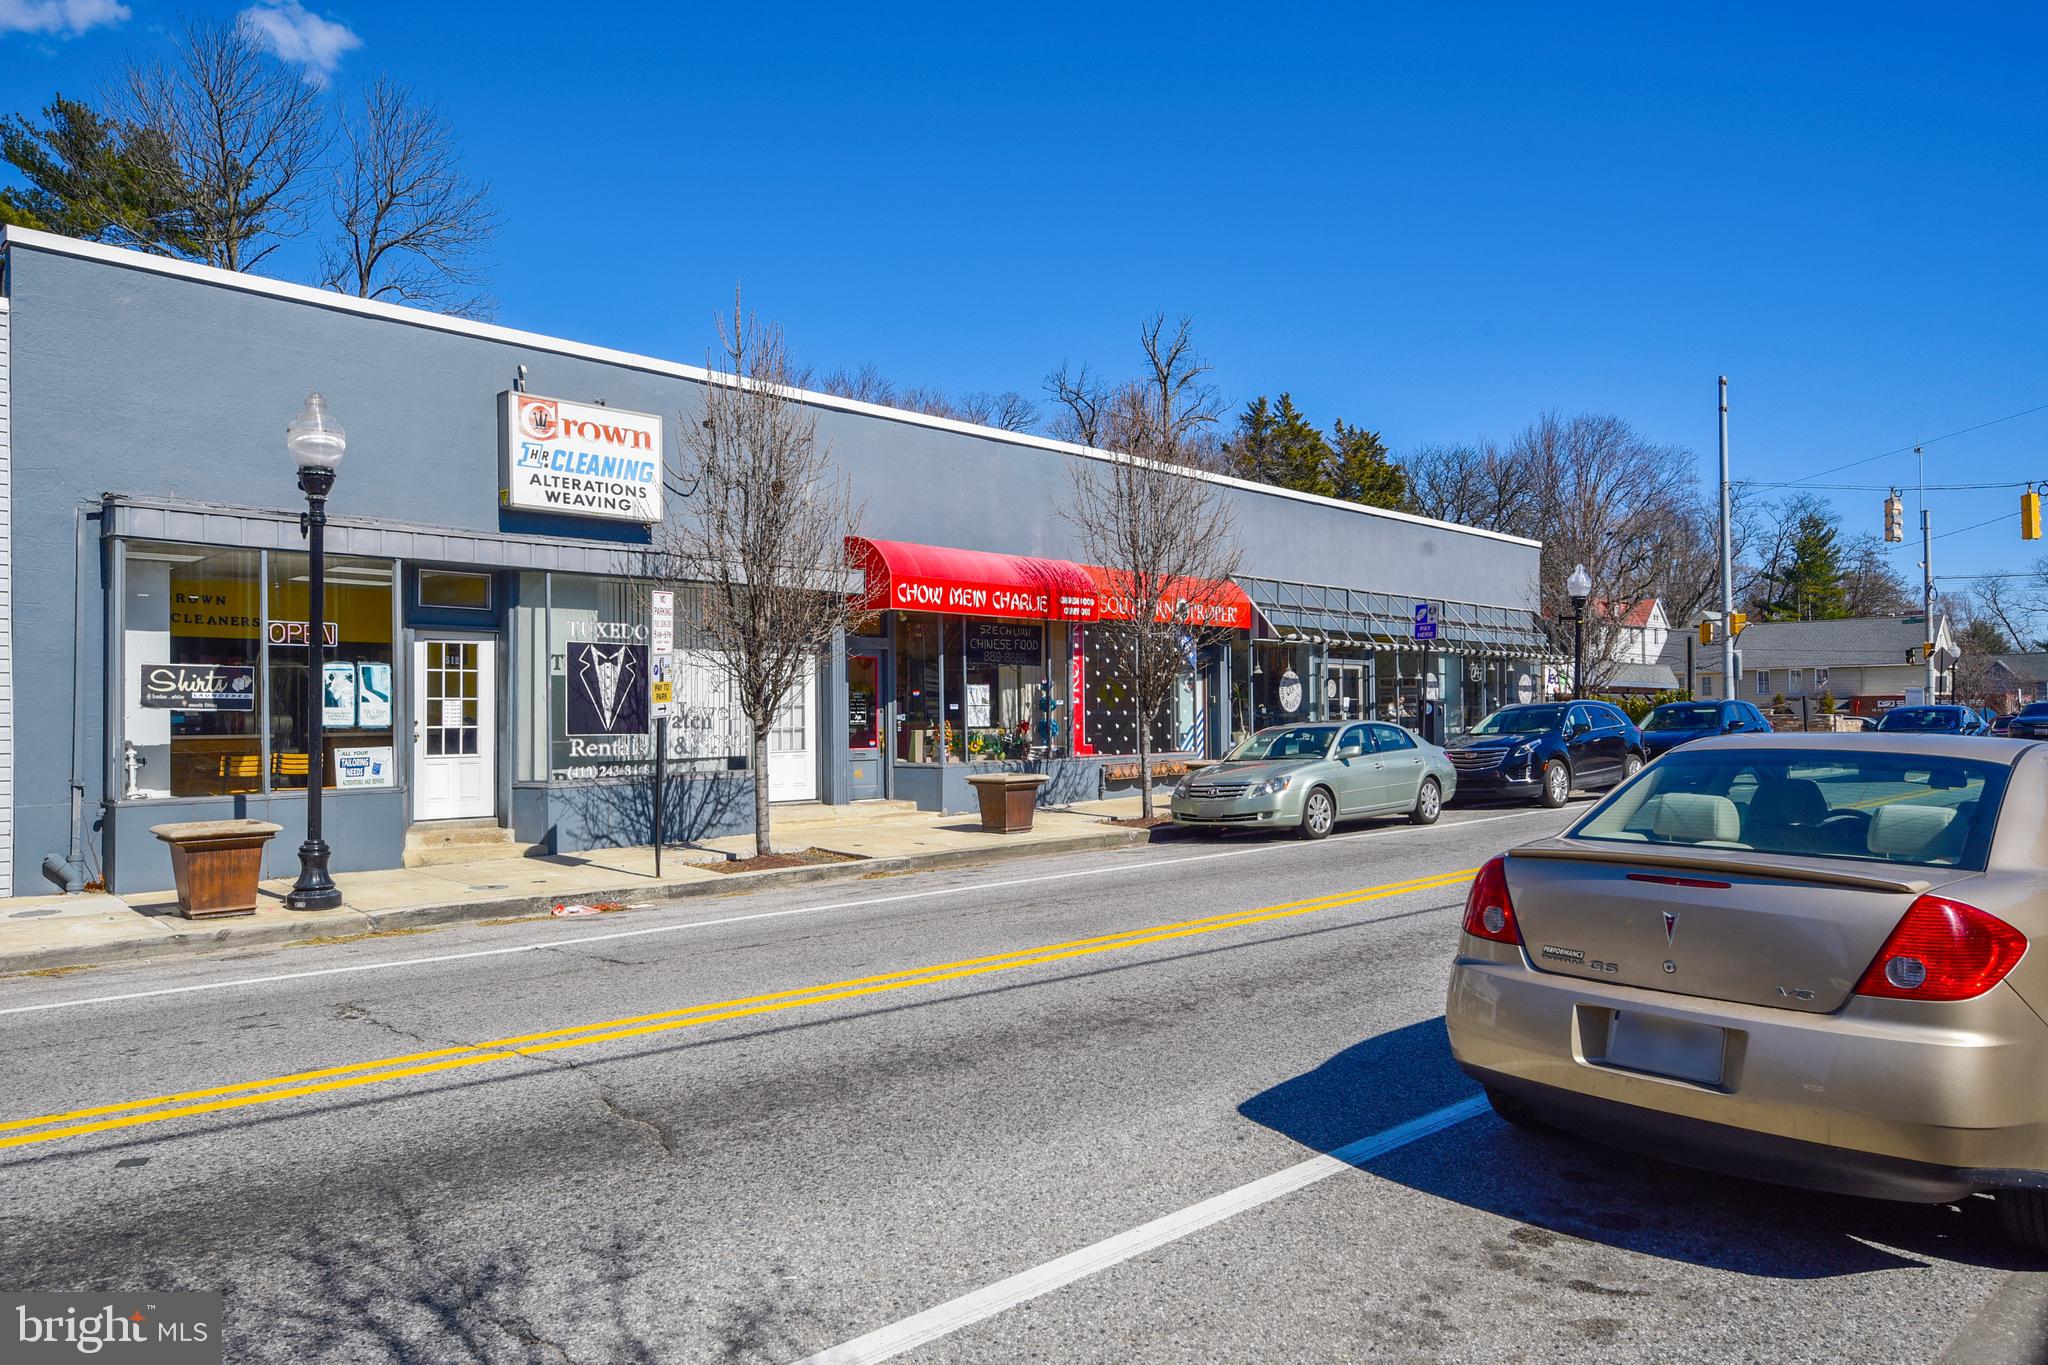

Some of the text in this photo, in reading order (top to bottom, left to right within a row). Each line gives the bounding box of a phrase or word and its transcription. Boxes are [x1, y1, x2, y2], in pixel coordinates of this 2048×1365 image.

[519, 398, 656, 450] Crown
[550, 449, 655, 483] CLEANING
[529, 473, 647, 498] ALTERATIONS
[544, 490, 632, 511] WEAVING
[170, 593, 227, 605] ROWN
[897, 583, 1049, 613] CHOW MEIN CHARLIE
[170, 612, 260, 628] CLEANERS
[567, 620, 650, 640] TUXEDO
[970, 639, 1039, 650] CHINESE FOOD
[147, 669, 228, 692] Shirts
[655, 684, 670, 692] PAY TO
[656, 693, 667, 701] PARK
[569, 738, 647, 757] Rentals
[1543, 945, 1585, 959] PERFORMANCE
